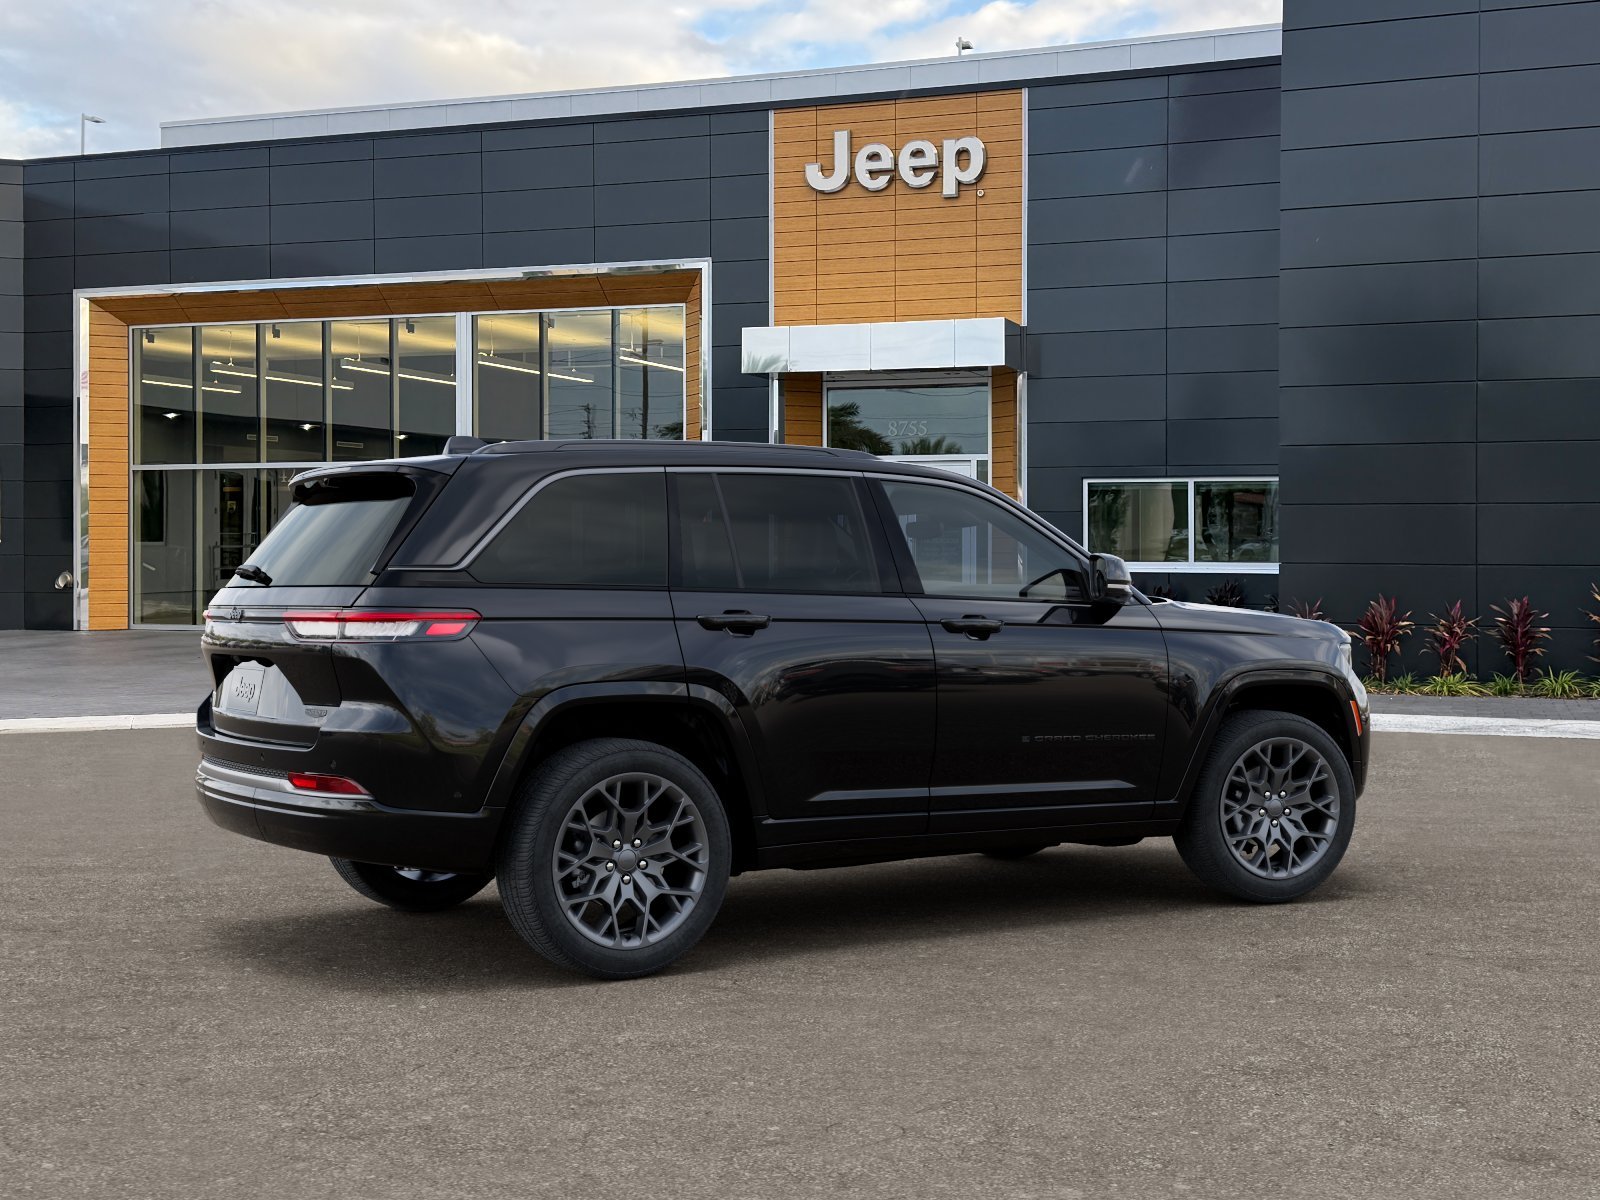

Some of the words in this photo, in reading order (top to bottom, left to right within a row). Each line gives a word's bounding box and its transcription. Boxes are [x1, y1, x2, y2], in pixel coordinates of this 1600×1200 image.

[804, 129, 988, 199] Jeep
[888, 420, 928, 437] 8755
[235, 676, 256, 703] Jeep
